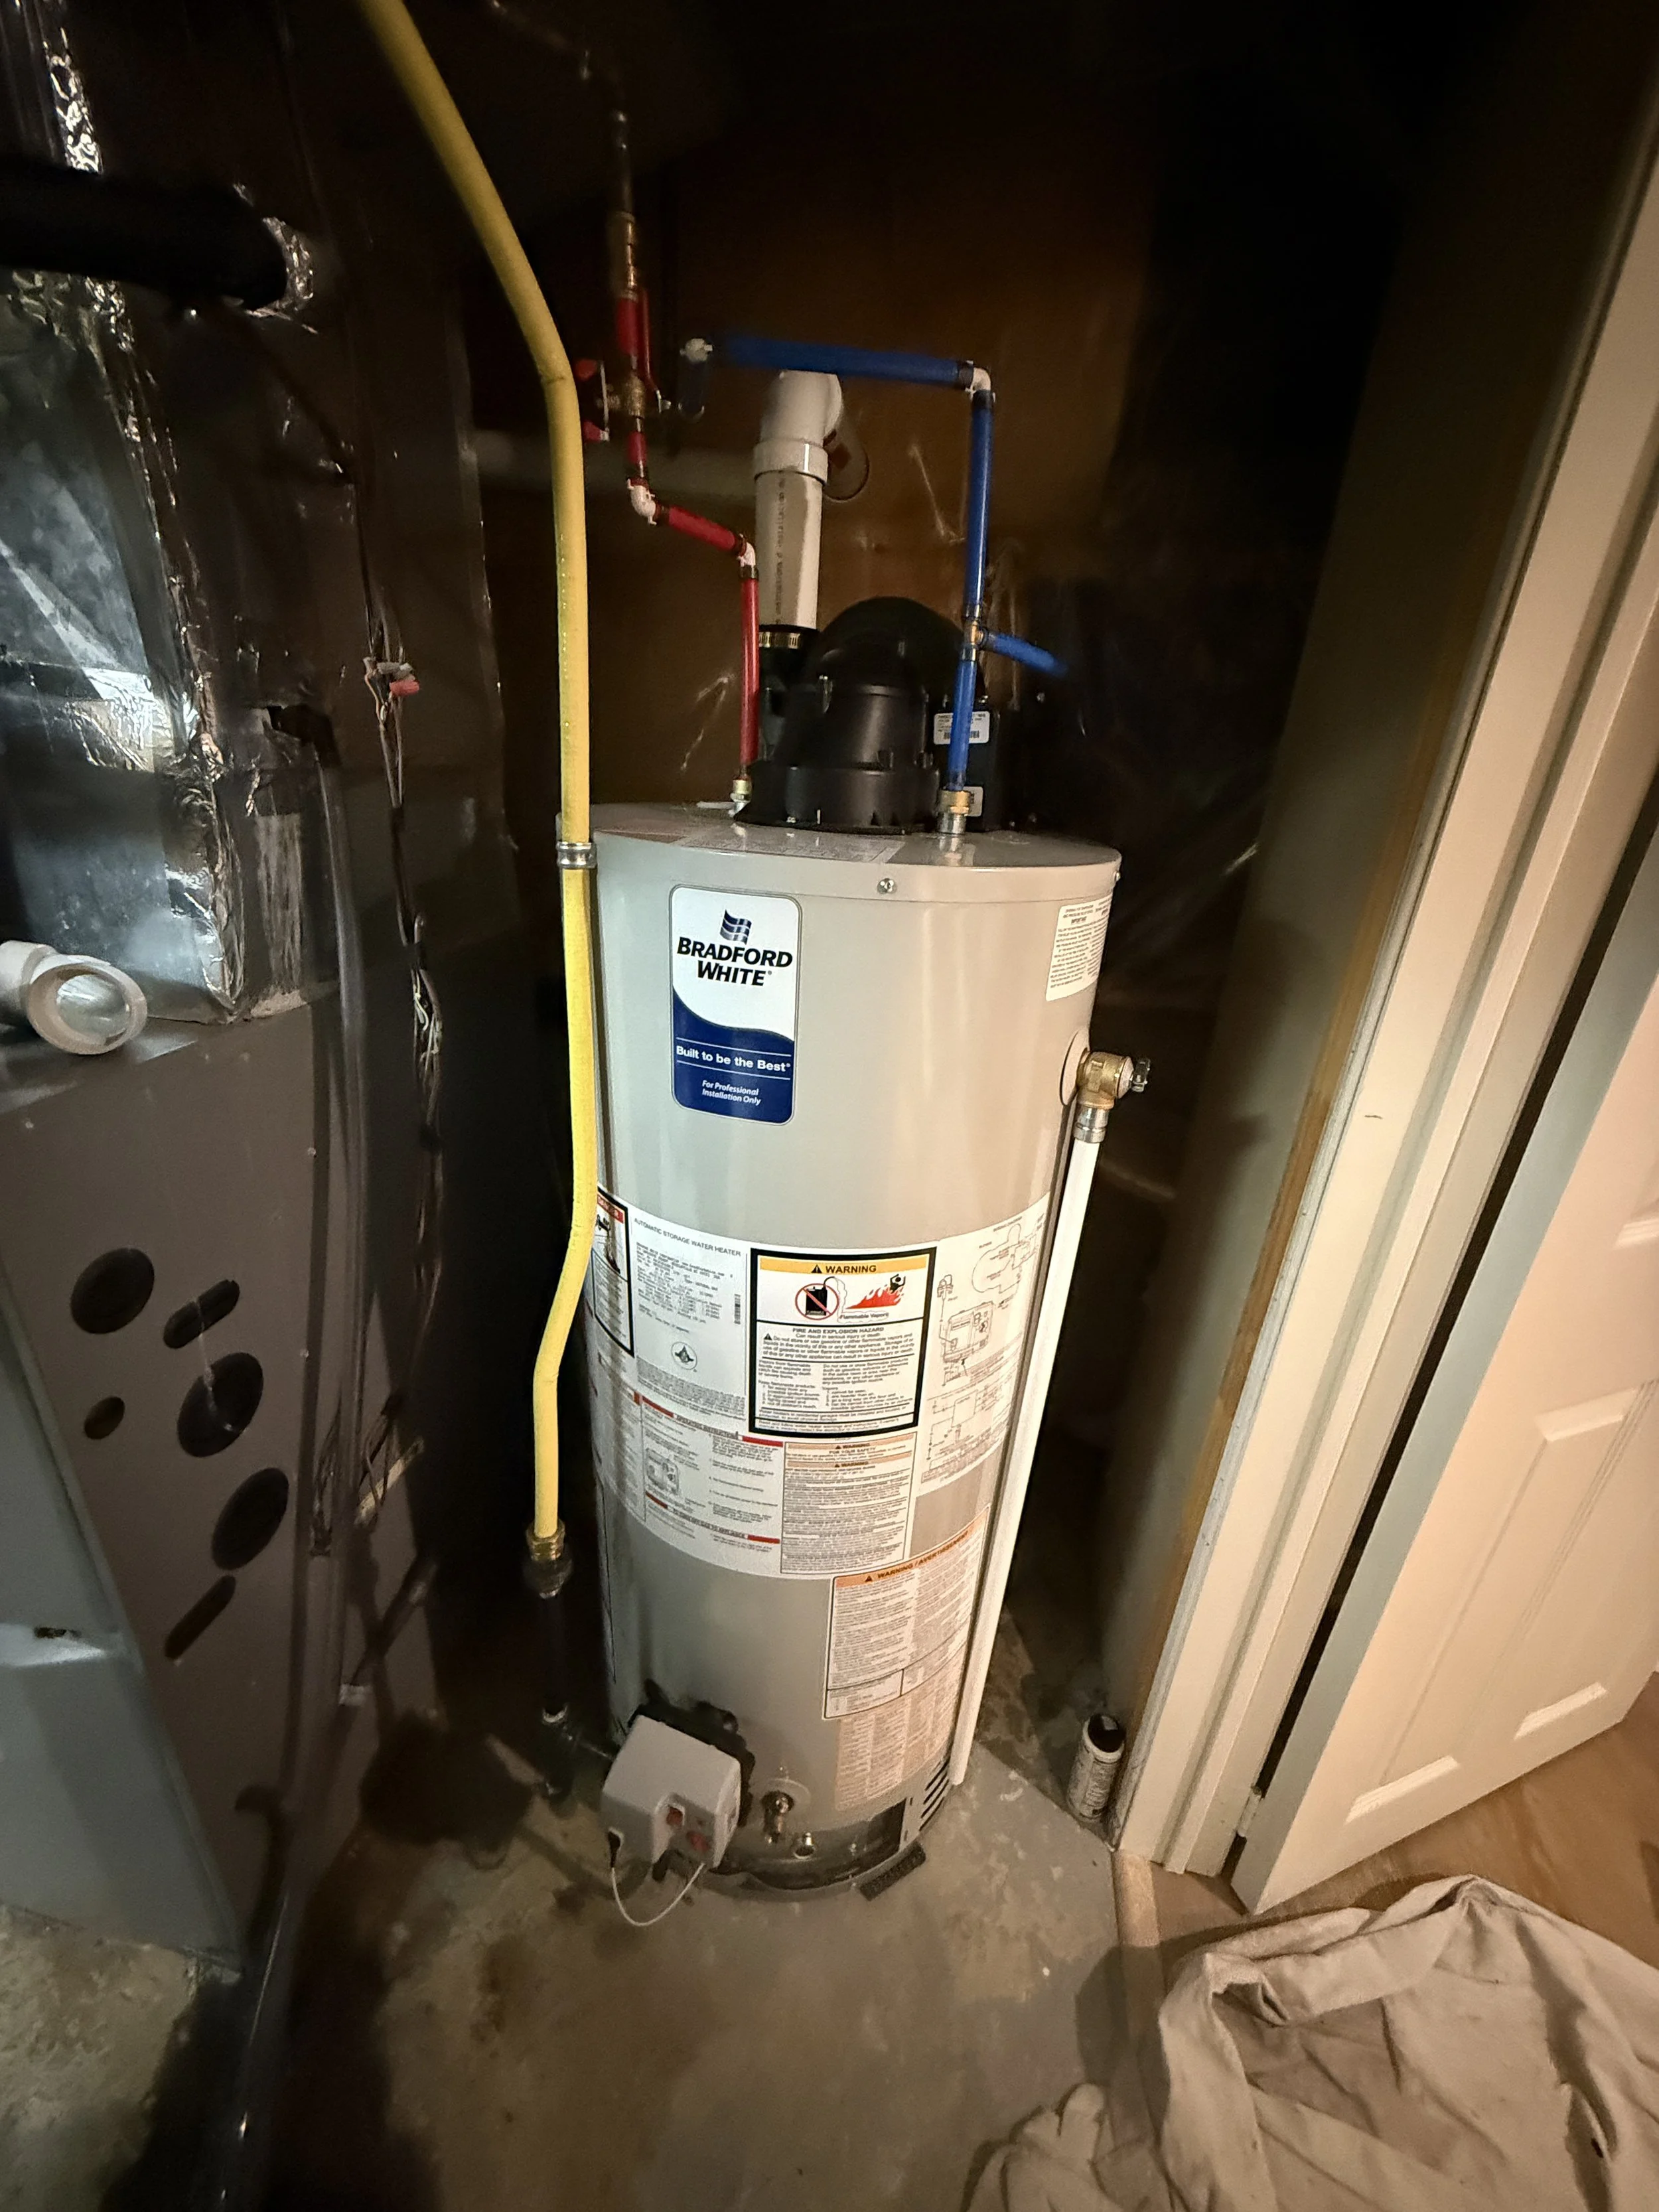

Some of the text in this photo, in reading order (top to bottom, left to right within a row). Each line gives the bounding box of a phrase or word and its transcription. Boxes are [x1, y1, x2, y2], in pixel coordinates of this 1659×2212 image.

[677, 937, 793, 968] BRADFORD
[697, 960, 766, 986] WHITE
[676, 1045, 699, 1060] Built
[701, 1051, 713, 1063] to
[716, 1053, 731, 1065] be
[734, 1055, 754, 1069] the
[702, 1079, 759, 1096] For Professional
[702, 1088, 762, 1106] Installation Only
[634, 1218, 742, 1258] AUTOMATIC STORAGE WATER HEATER
[825, 1265, 877, 1274] WARNING
[877, 1563, 914, 1578] WARNING
